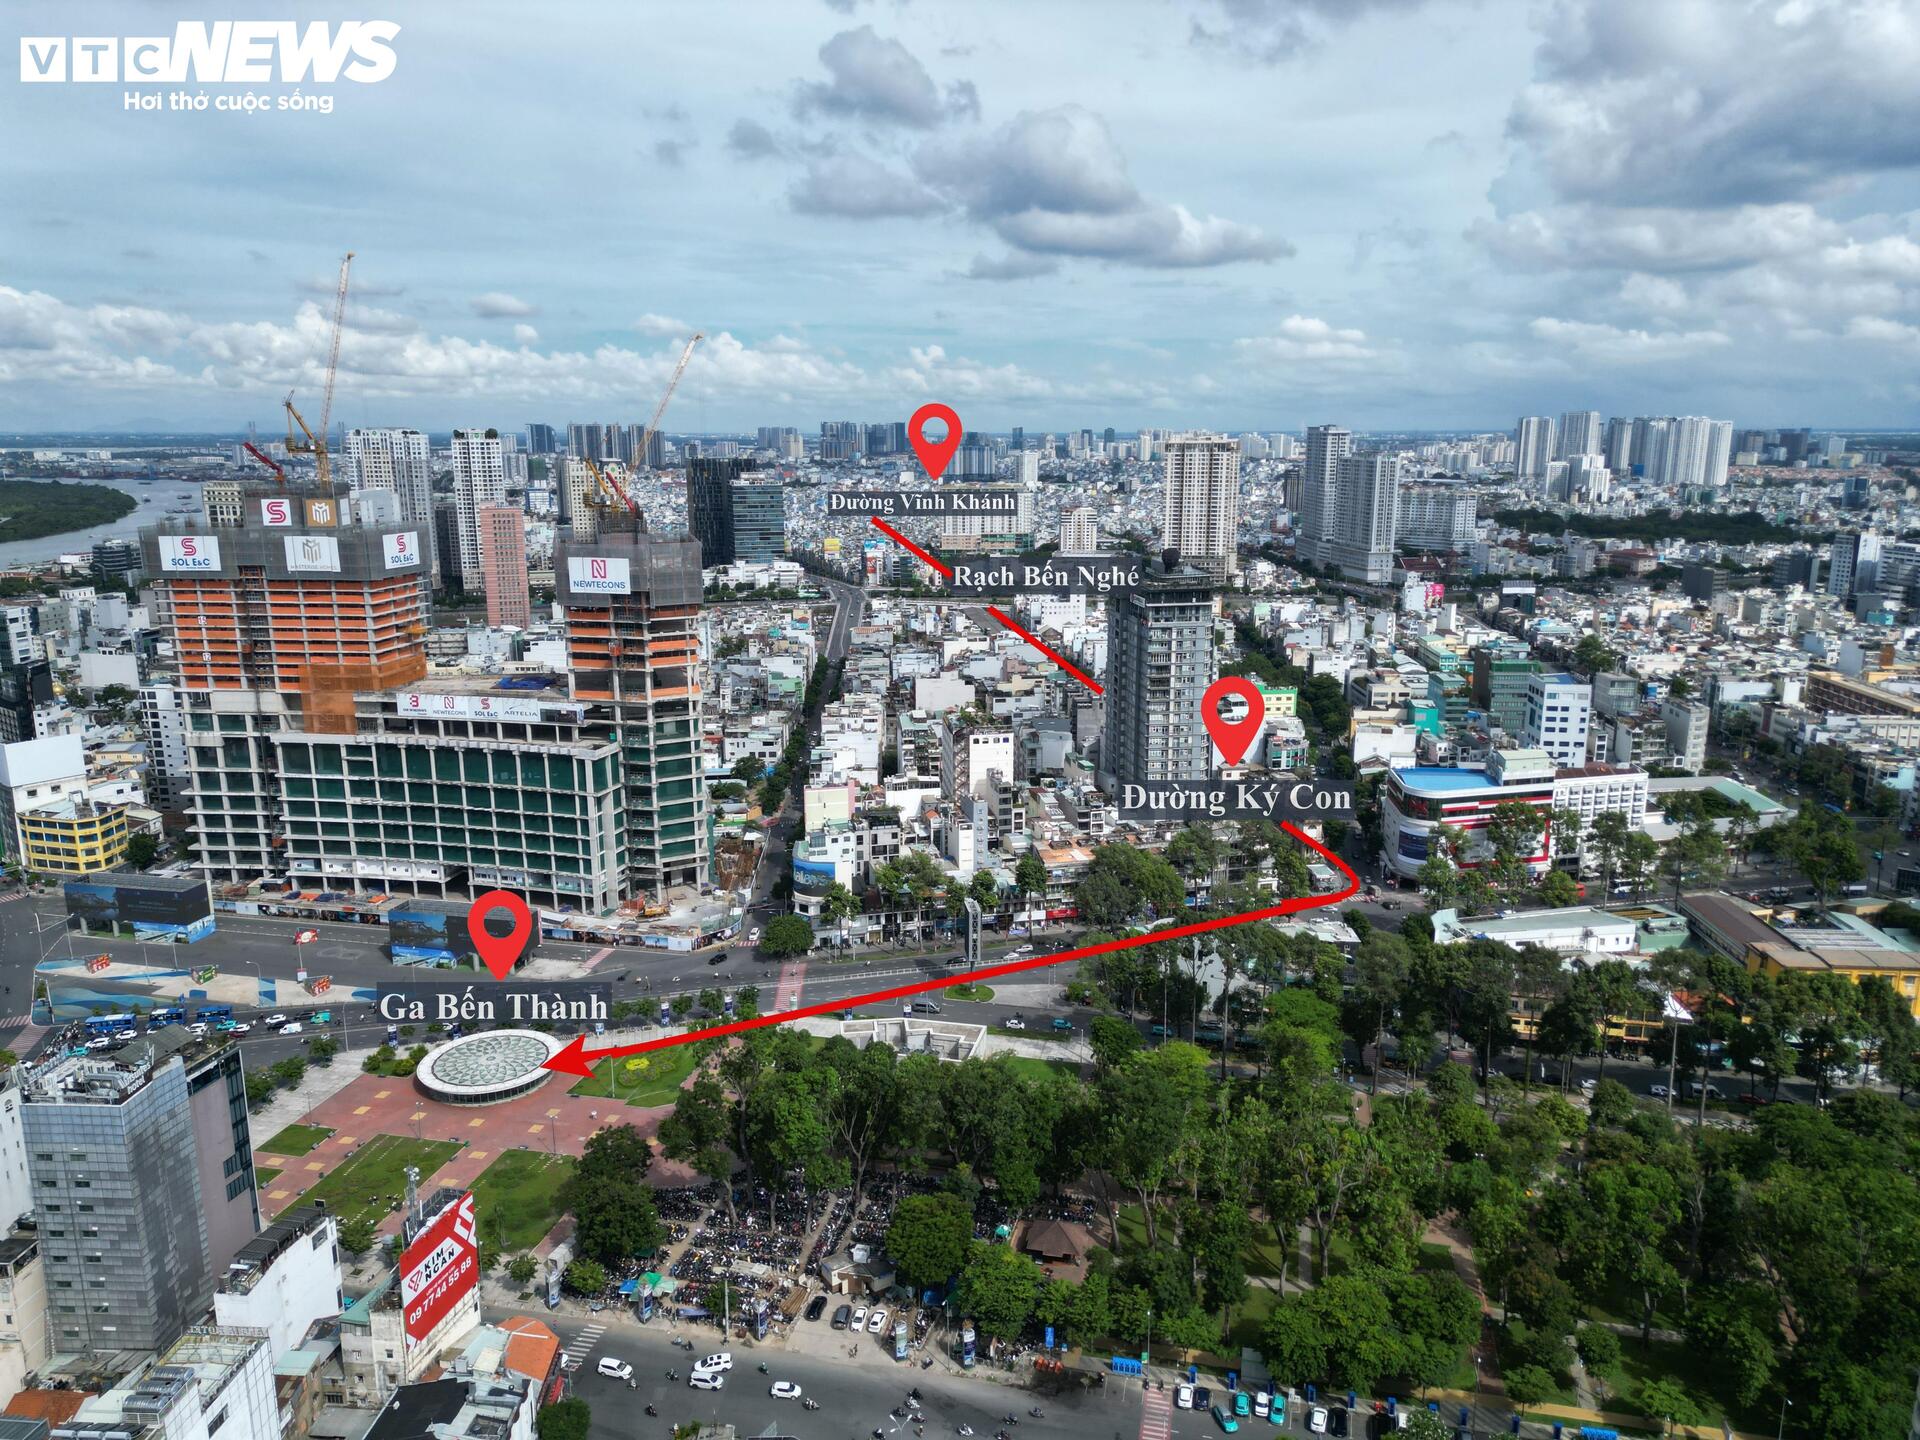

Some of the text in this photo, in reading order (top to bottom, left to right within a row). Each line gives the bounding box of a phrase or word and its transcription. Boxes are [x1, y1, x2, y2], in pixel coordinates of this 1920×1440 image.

[171, 558, 190, 567] SOL
[391, 555, 402, 564] SOL
[573, 580, 626, 589] NEWTECONS
[424, 1247, 444, 1272] KIM
[425, 1247, 454, 1282] NGAN
[410, 1256, 472, 1325] 09 77 44 55 88
